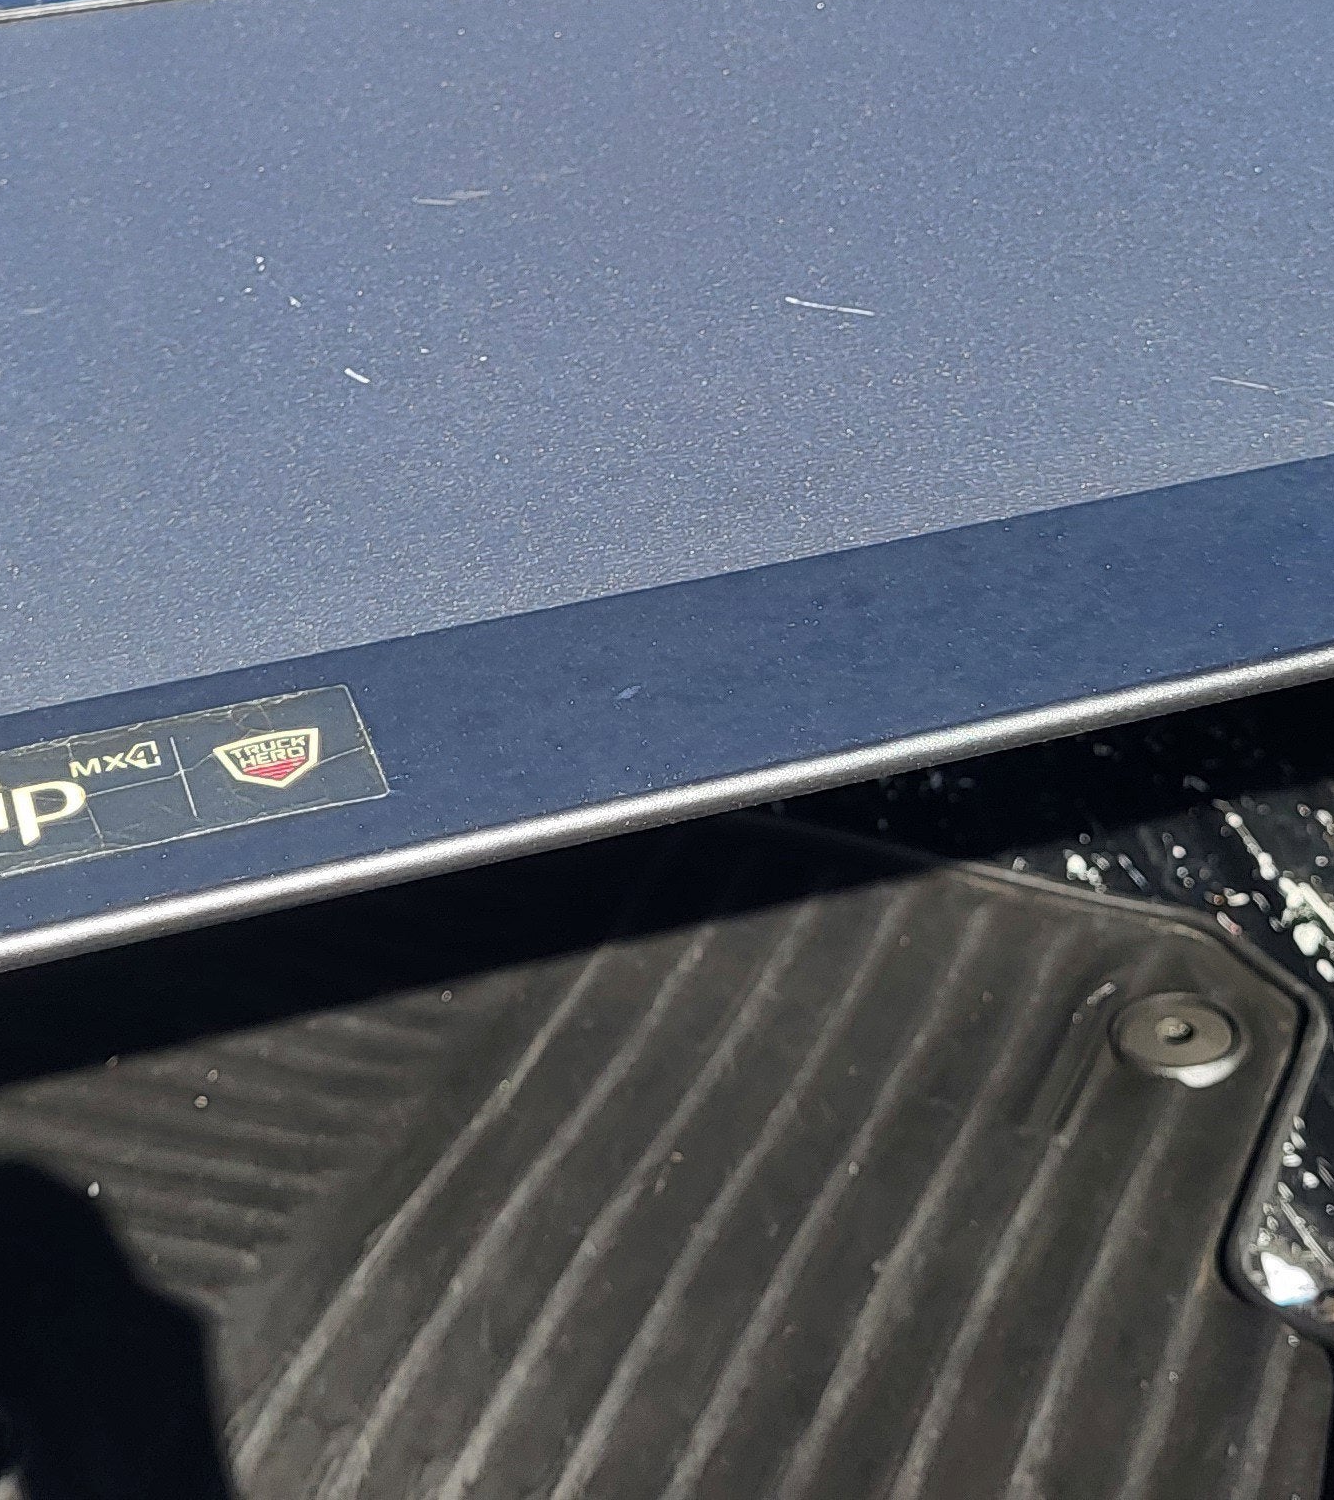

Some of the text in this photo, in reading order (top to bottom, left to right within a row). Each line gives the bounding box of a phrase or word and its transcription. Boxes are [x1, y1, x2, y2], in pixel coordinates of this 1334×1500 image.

[229, 735, 306, 759] TRUCK
[238, 746, 306, 769] HERO
[67, 740, 162, 779] MX4
